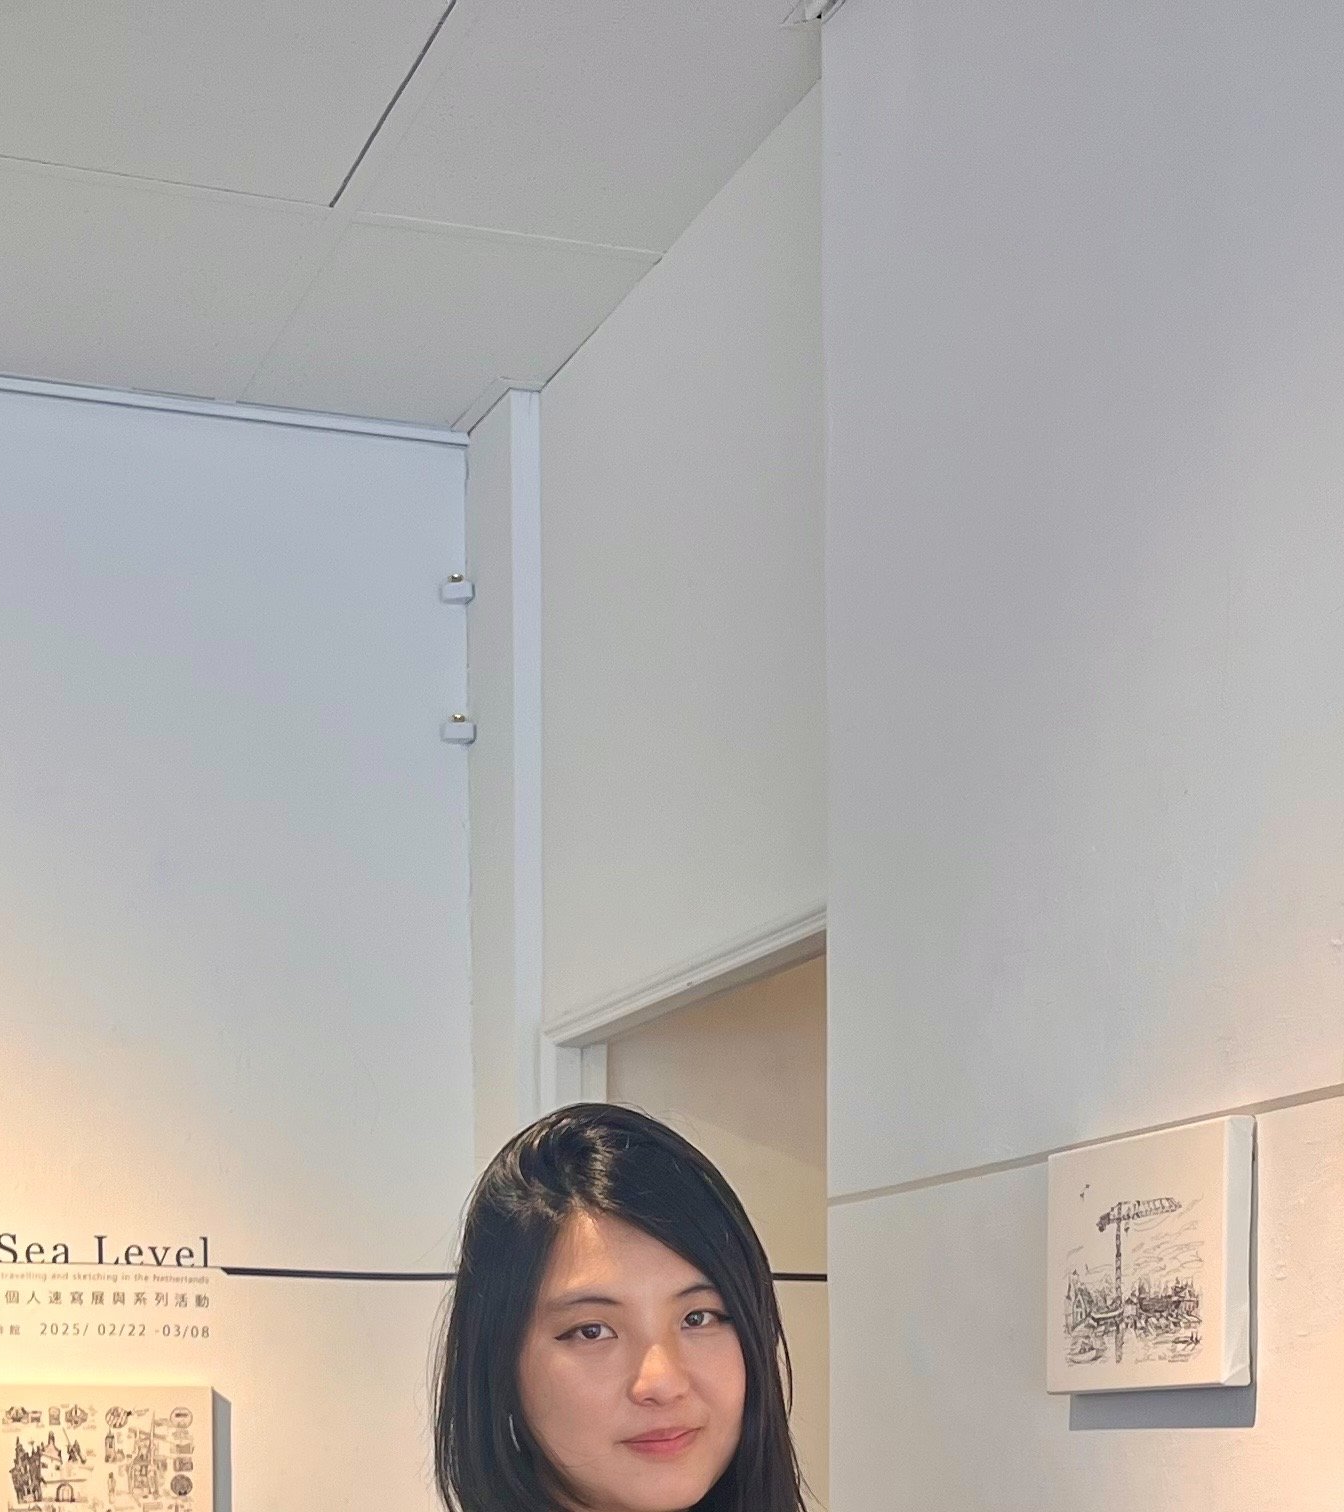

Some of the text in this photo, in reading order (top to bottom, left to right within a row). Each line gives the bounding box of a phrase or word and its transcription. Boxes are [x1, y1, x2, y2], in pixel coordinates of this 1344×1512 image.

[93, 1234, 210, 1268] Level
[1, 1271, 48, 1283] travelling
[51, 1272, 70, 1282] and
[72, 1272, 119, 1284] sketching
[121, 1273, 131, 1283] in
[134, 1273, 149, 1283] the
[152, 1274, 210, 1286] Netherlands
[39, 1322, 90, 1337] 2025/
[97, 1323, 147, 1338] 02/22
